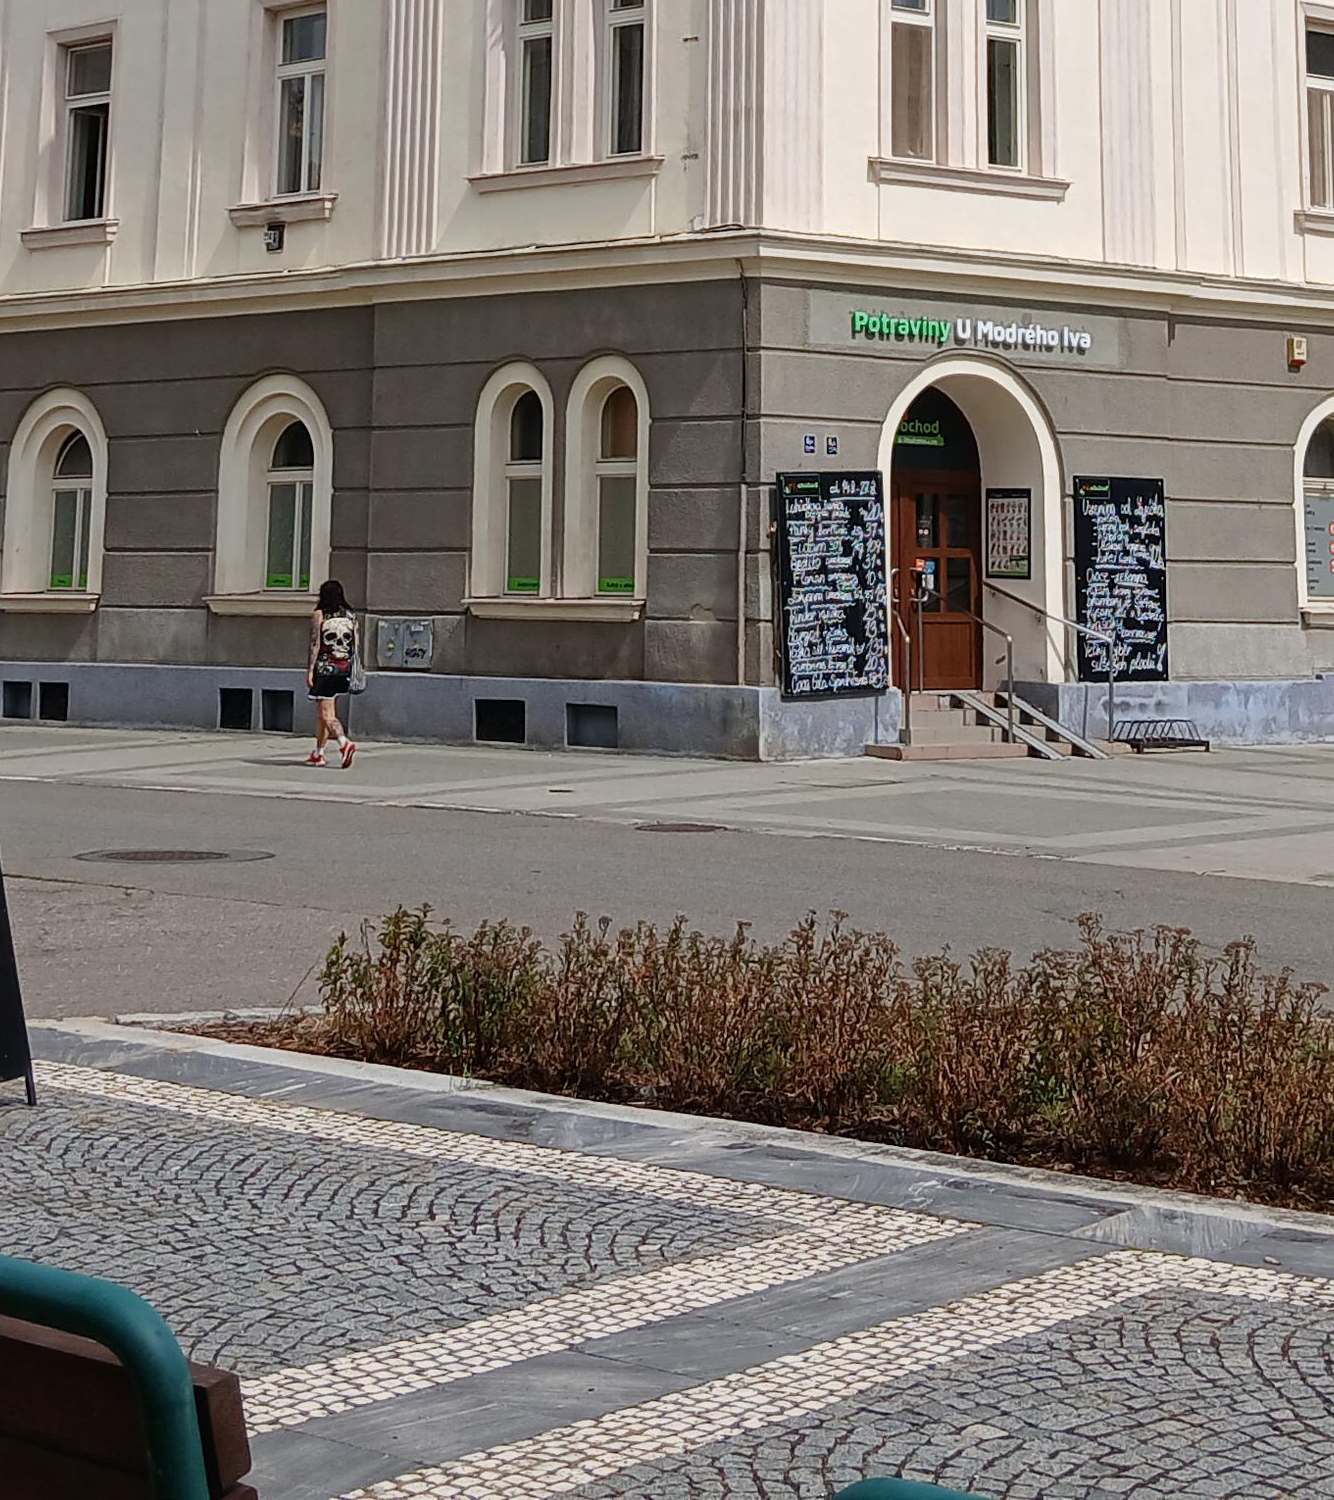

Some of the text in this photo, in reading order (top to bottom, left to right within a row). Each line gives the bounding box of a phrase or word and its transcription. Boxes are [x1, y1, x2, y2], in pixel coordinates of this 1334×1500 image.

[853, 311, 952, 343] Potraviny
[955, 318, 972, 340] U
[977, 320, 1059, 347] Modrého
